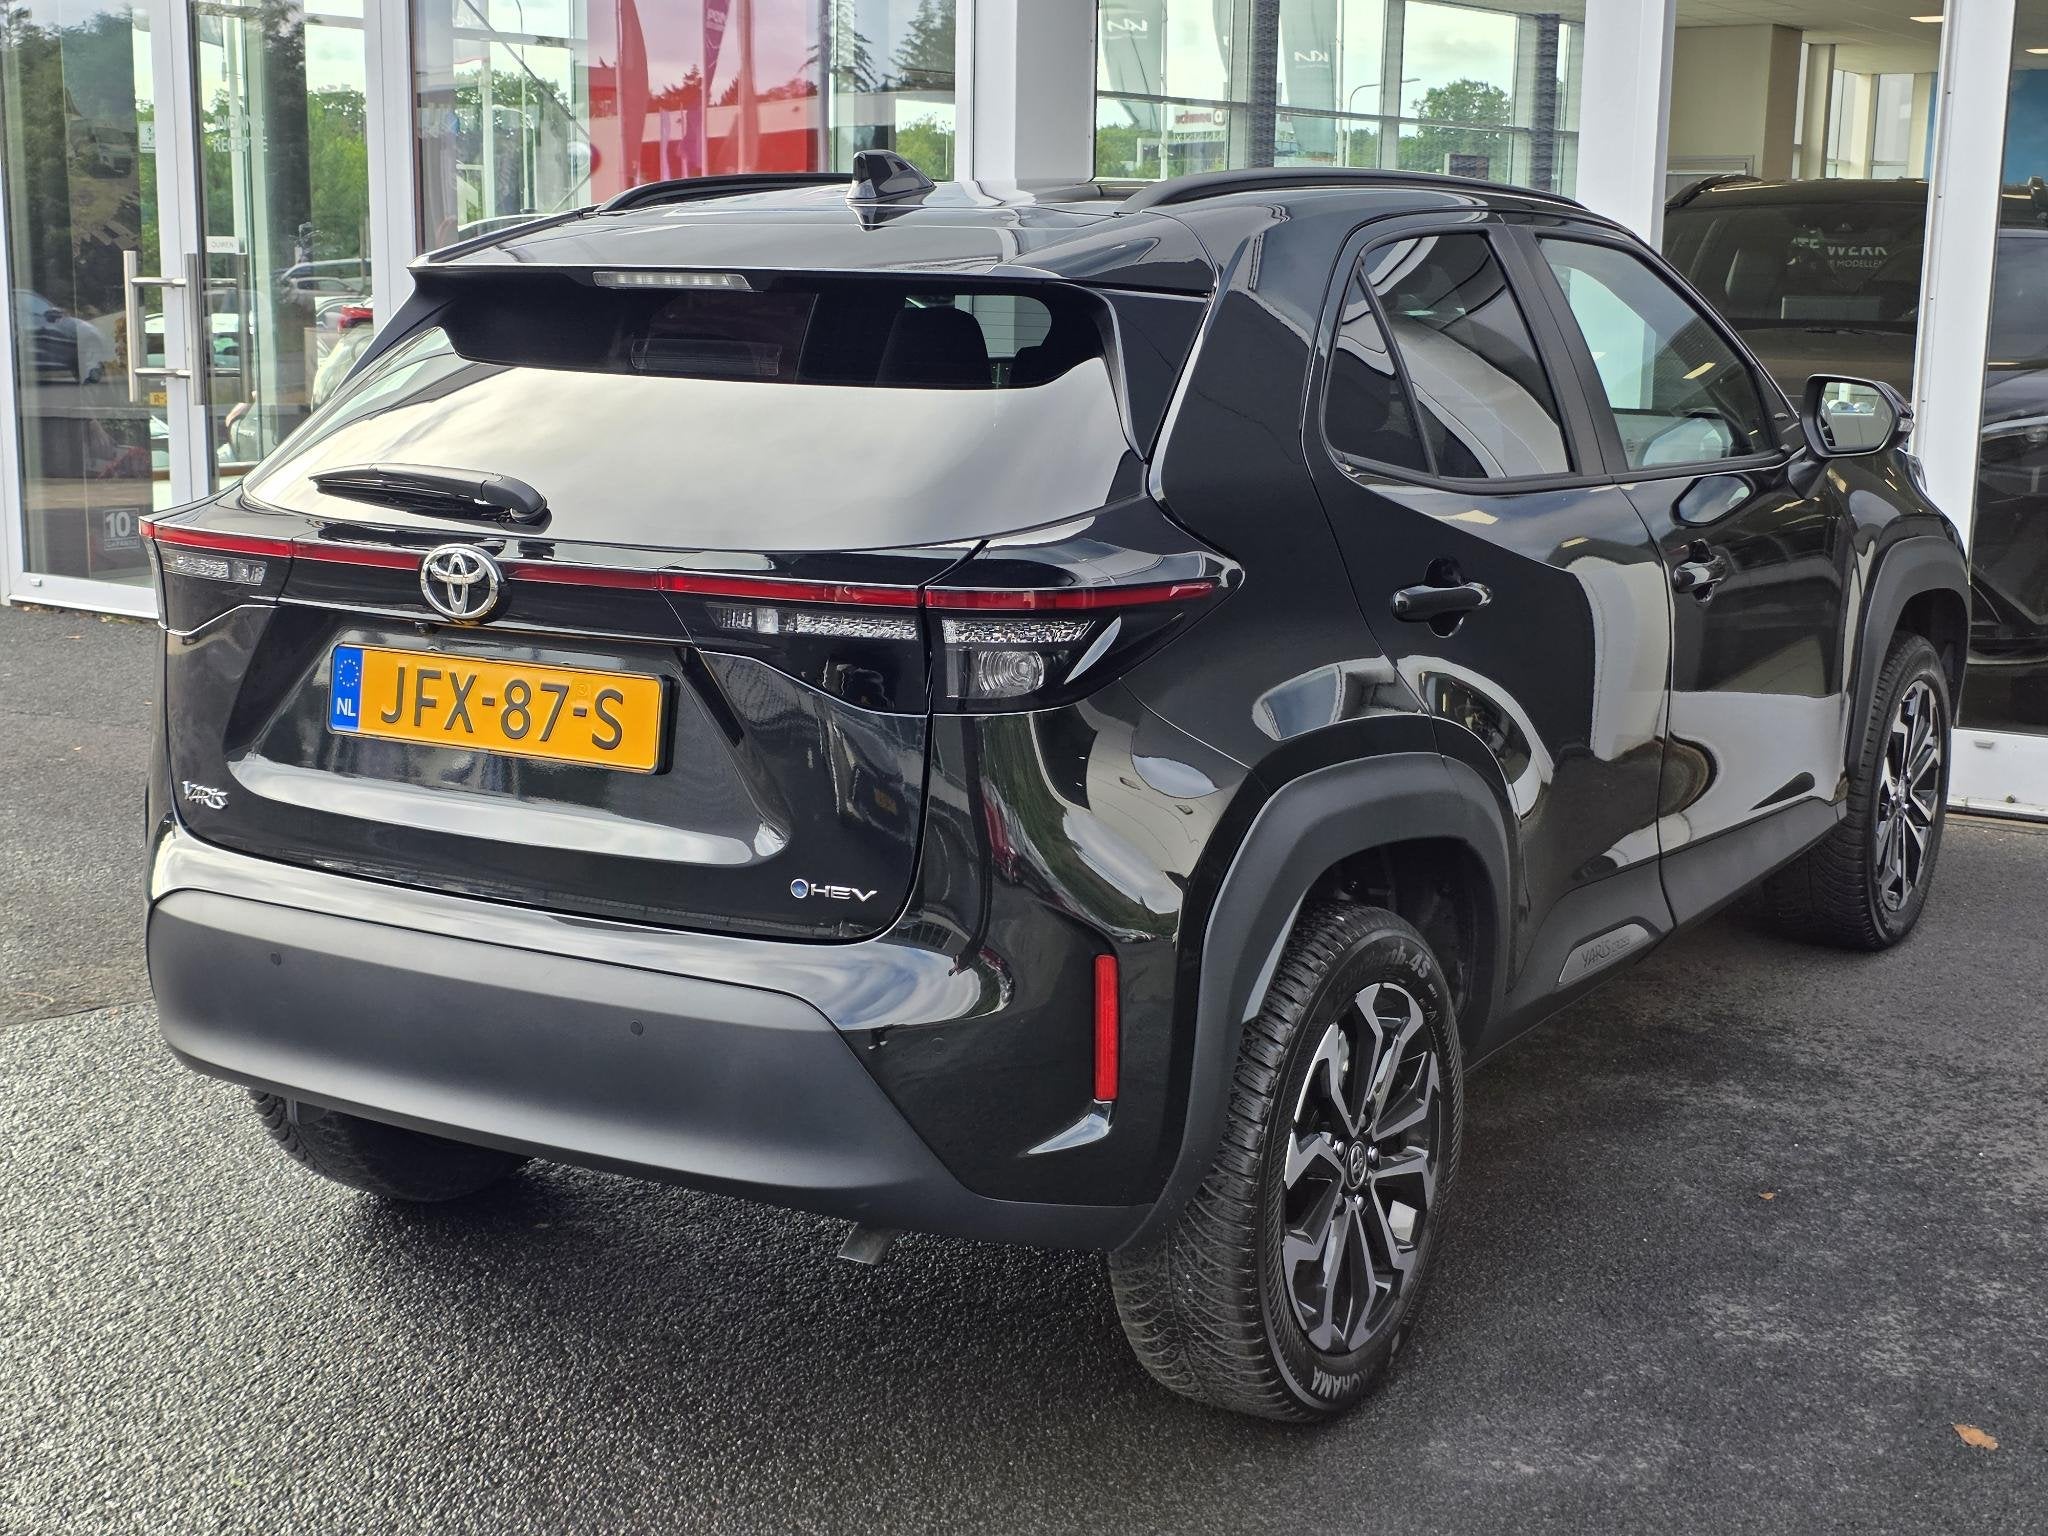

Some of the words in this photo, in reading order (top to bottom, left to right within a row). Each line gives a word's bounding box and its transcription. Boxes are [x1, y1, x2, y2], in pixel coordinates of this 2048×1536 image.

[106, 511, 130, 538] 10
[336, 697, 357, 718] NL
[380, 666, 625, 751] JFX-87-S
[810, 883, 878, 902] HEV
